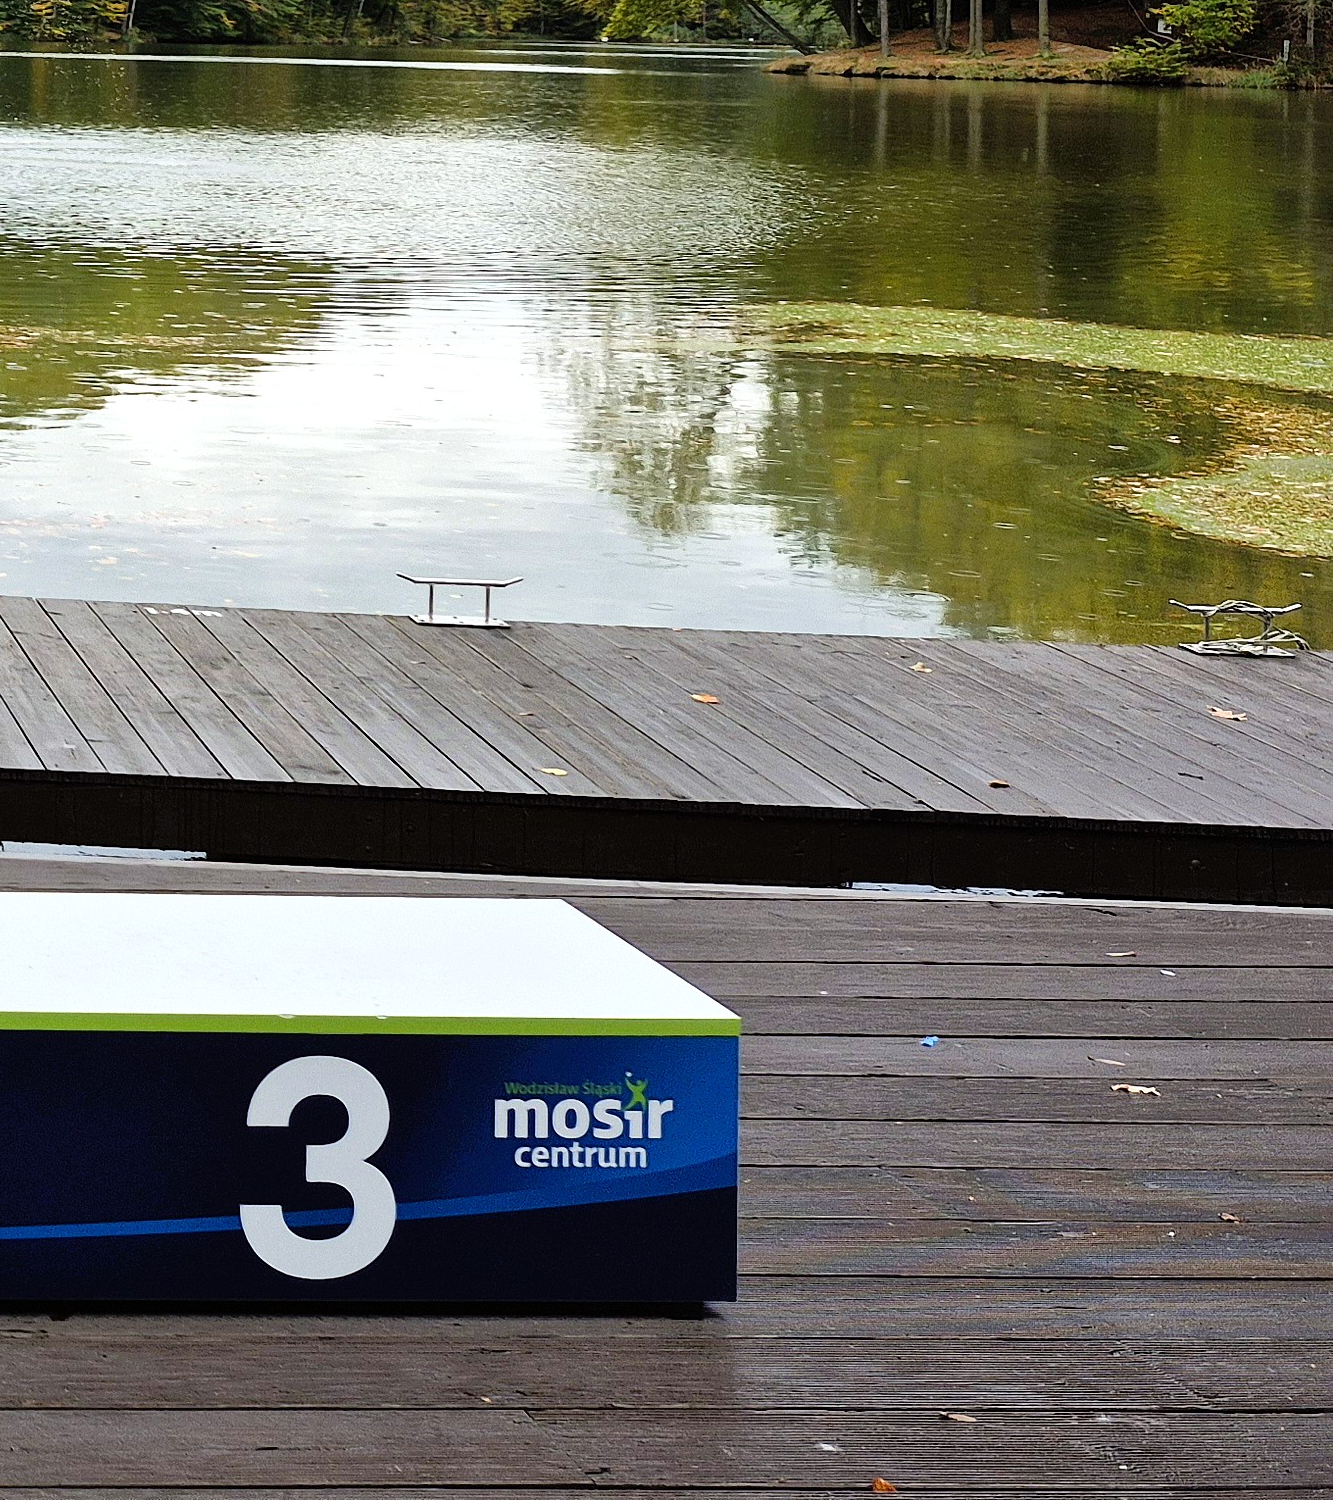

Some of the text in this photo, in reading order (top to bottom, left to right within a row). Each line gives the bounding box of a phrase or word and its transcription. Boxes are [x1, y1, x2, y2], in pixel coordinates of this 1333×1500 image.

[504, 1079, 622, 1097] Wodzisław Śląski
[494, 1098, 674, 1139] mosir
[239, 1055, 397, 1280] 3
[514, 1141, 648, 1168] centrum
